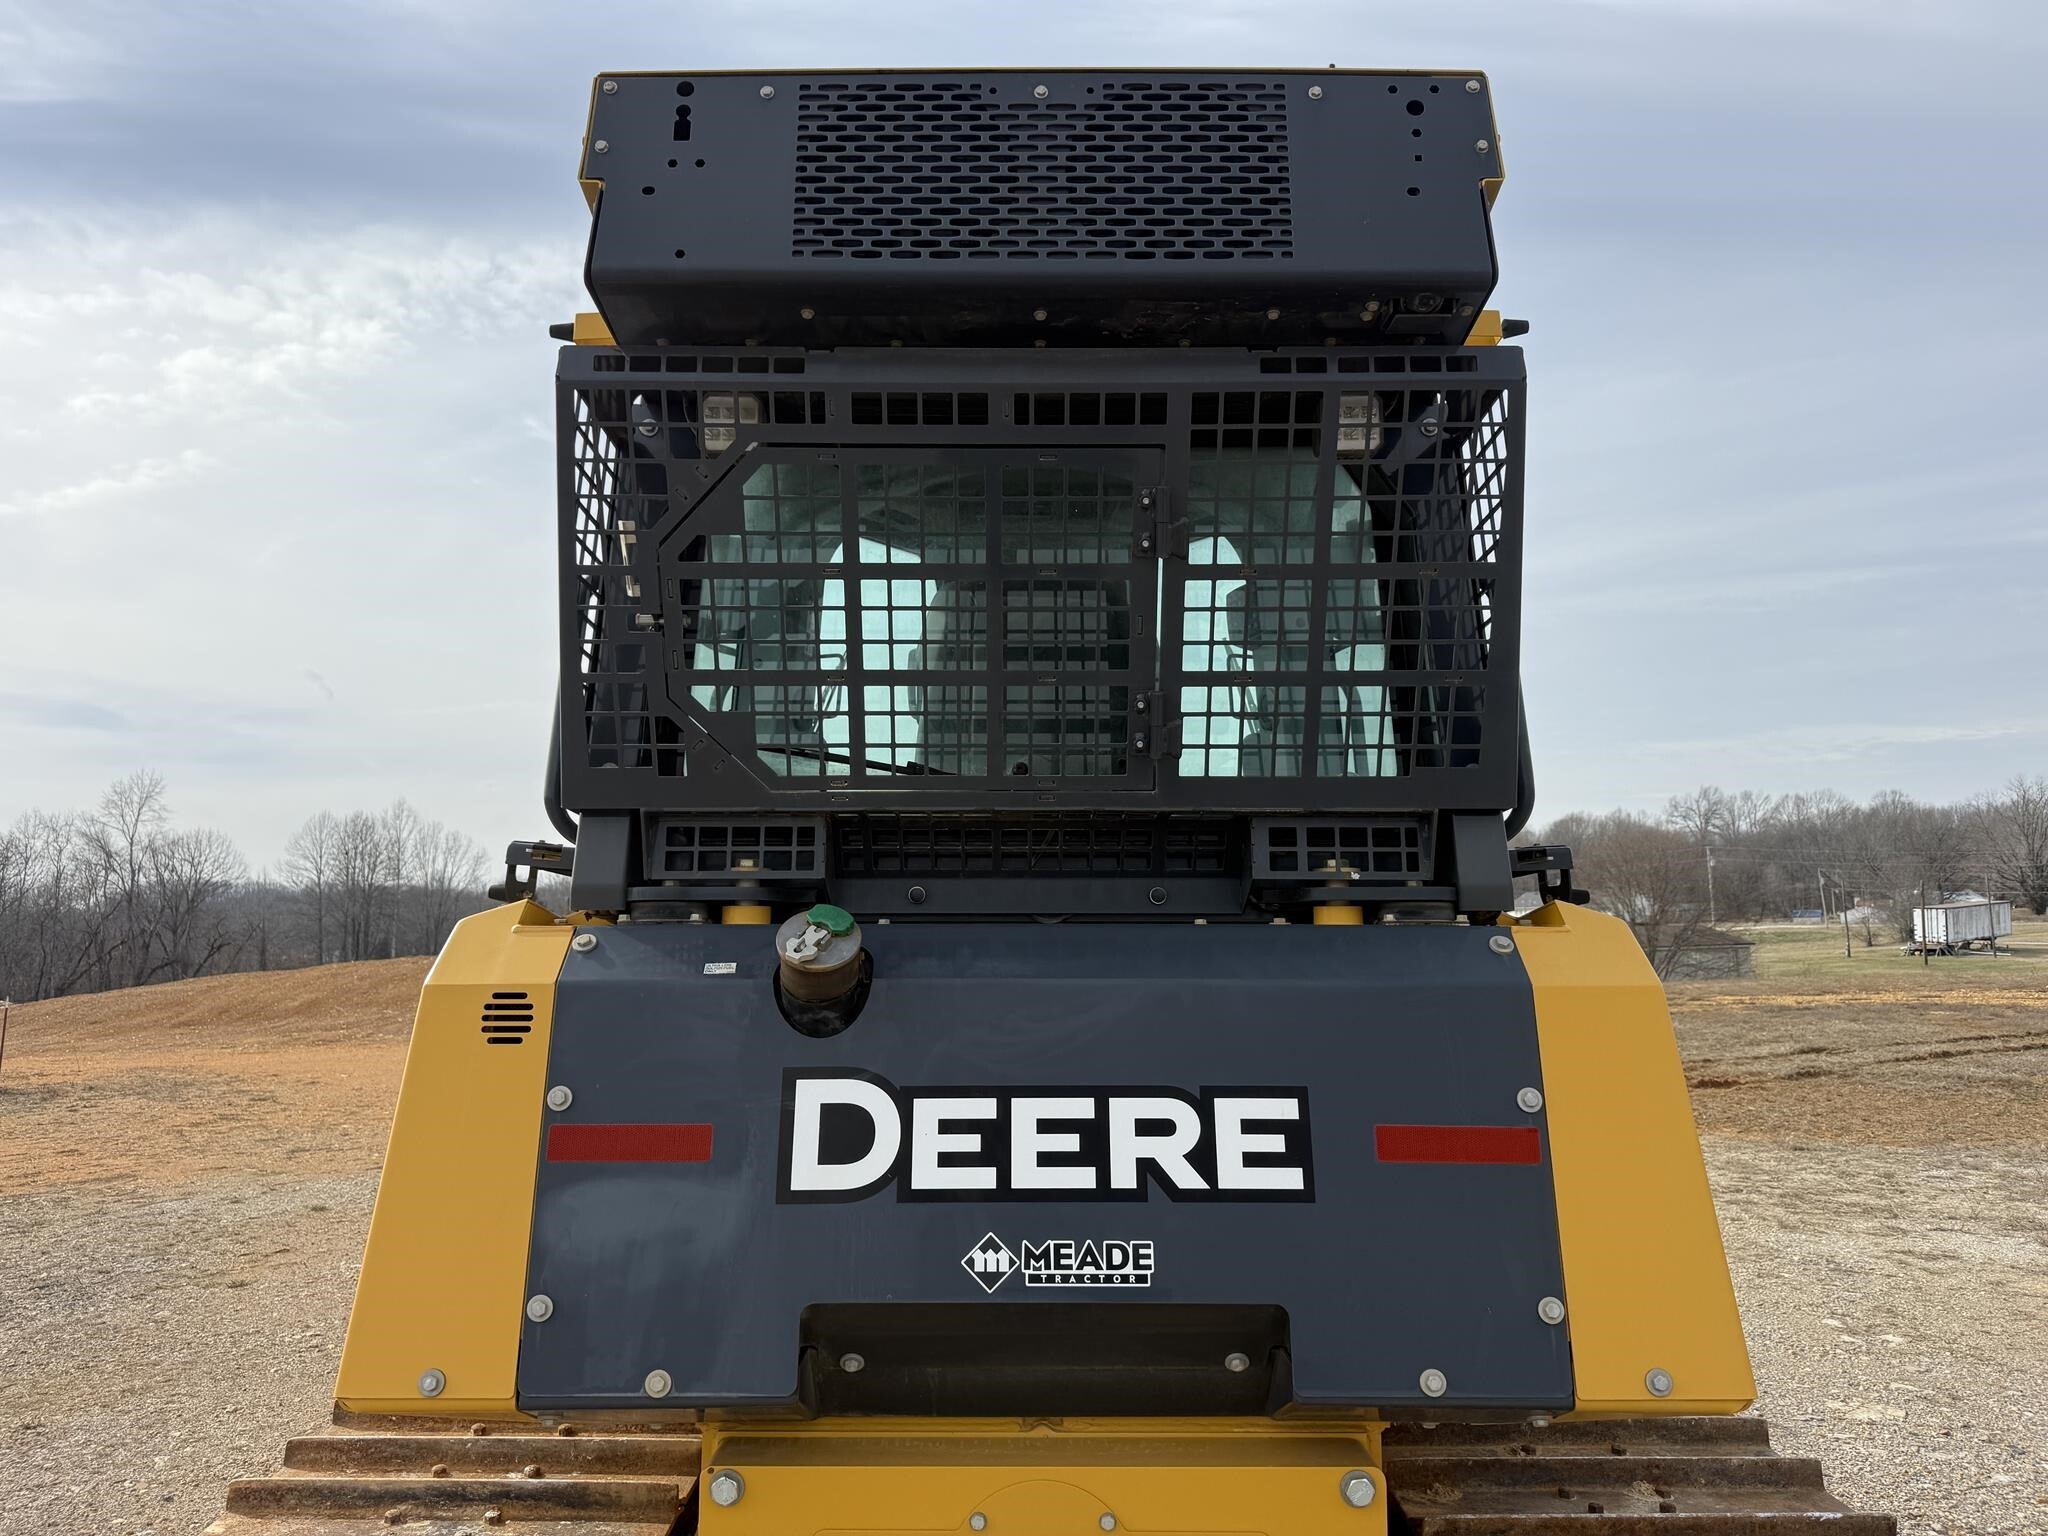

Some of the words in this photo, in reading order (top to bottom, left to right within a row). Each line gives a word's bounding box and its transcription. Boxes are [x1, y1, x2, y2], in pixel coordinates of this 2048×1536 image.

[790, 1078, 1304, 1191] DEERE
[1022, 1239, 1154, 1273] MEADE
[1041, 1275, 1136, 1283] TRACTOR
